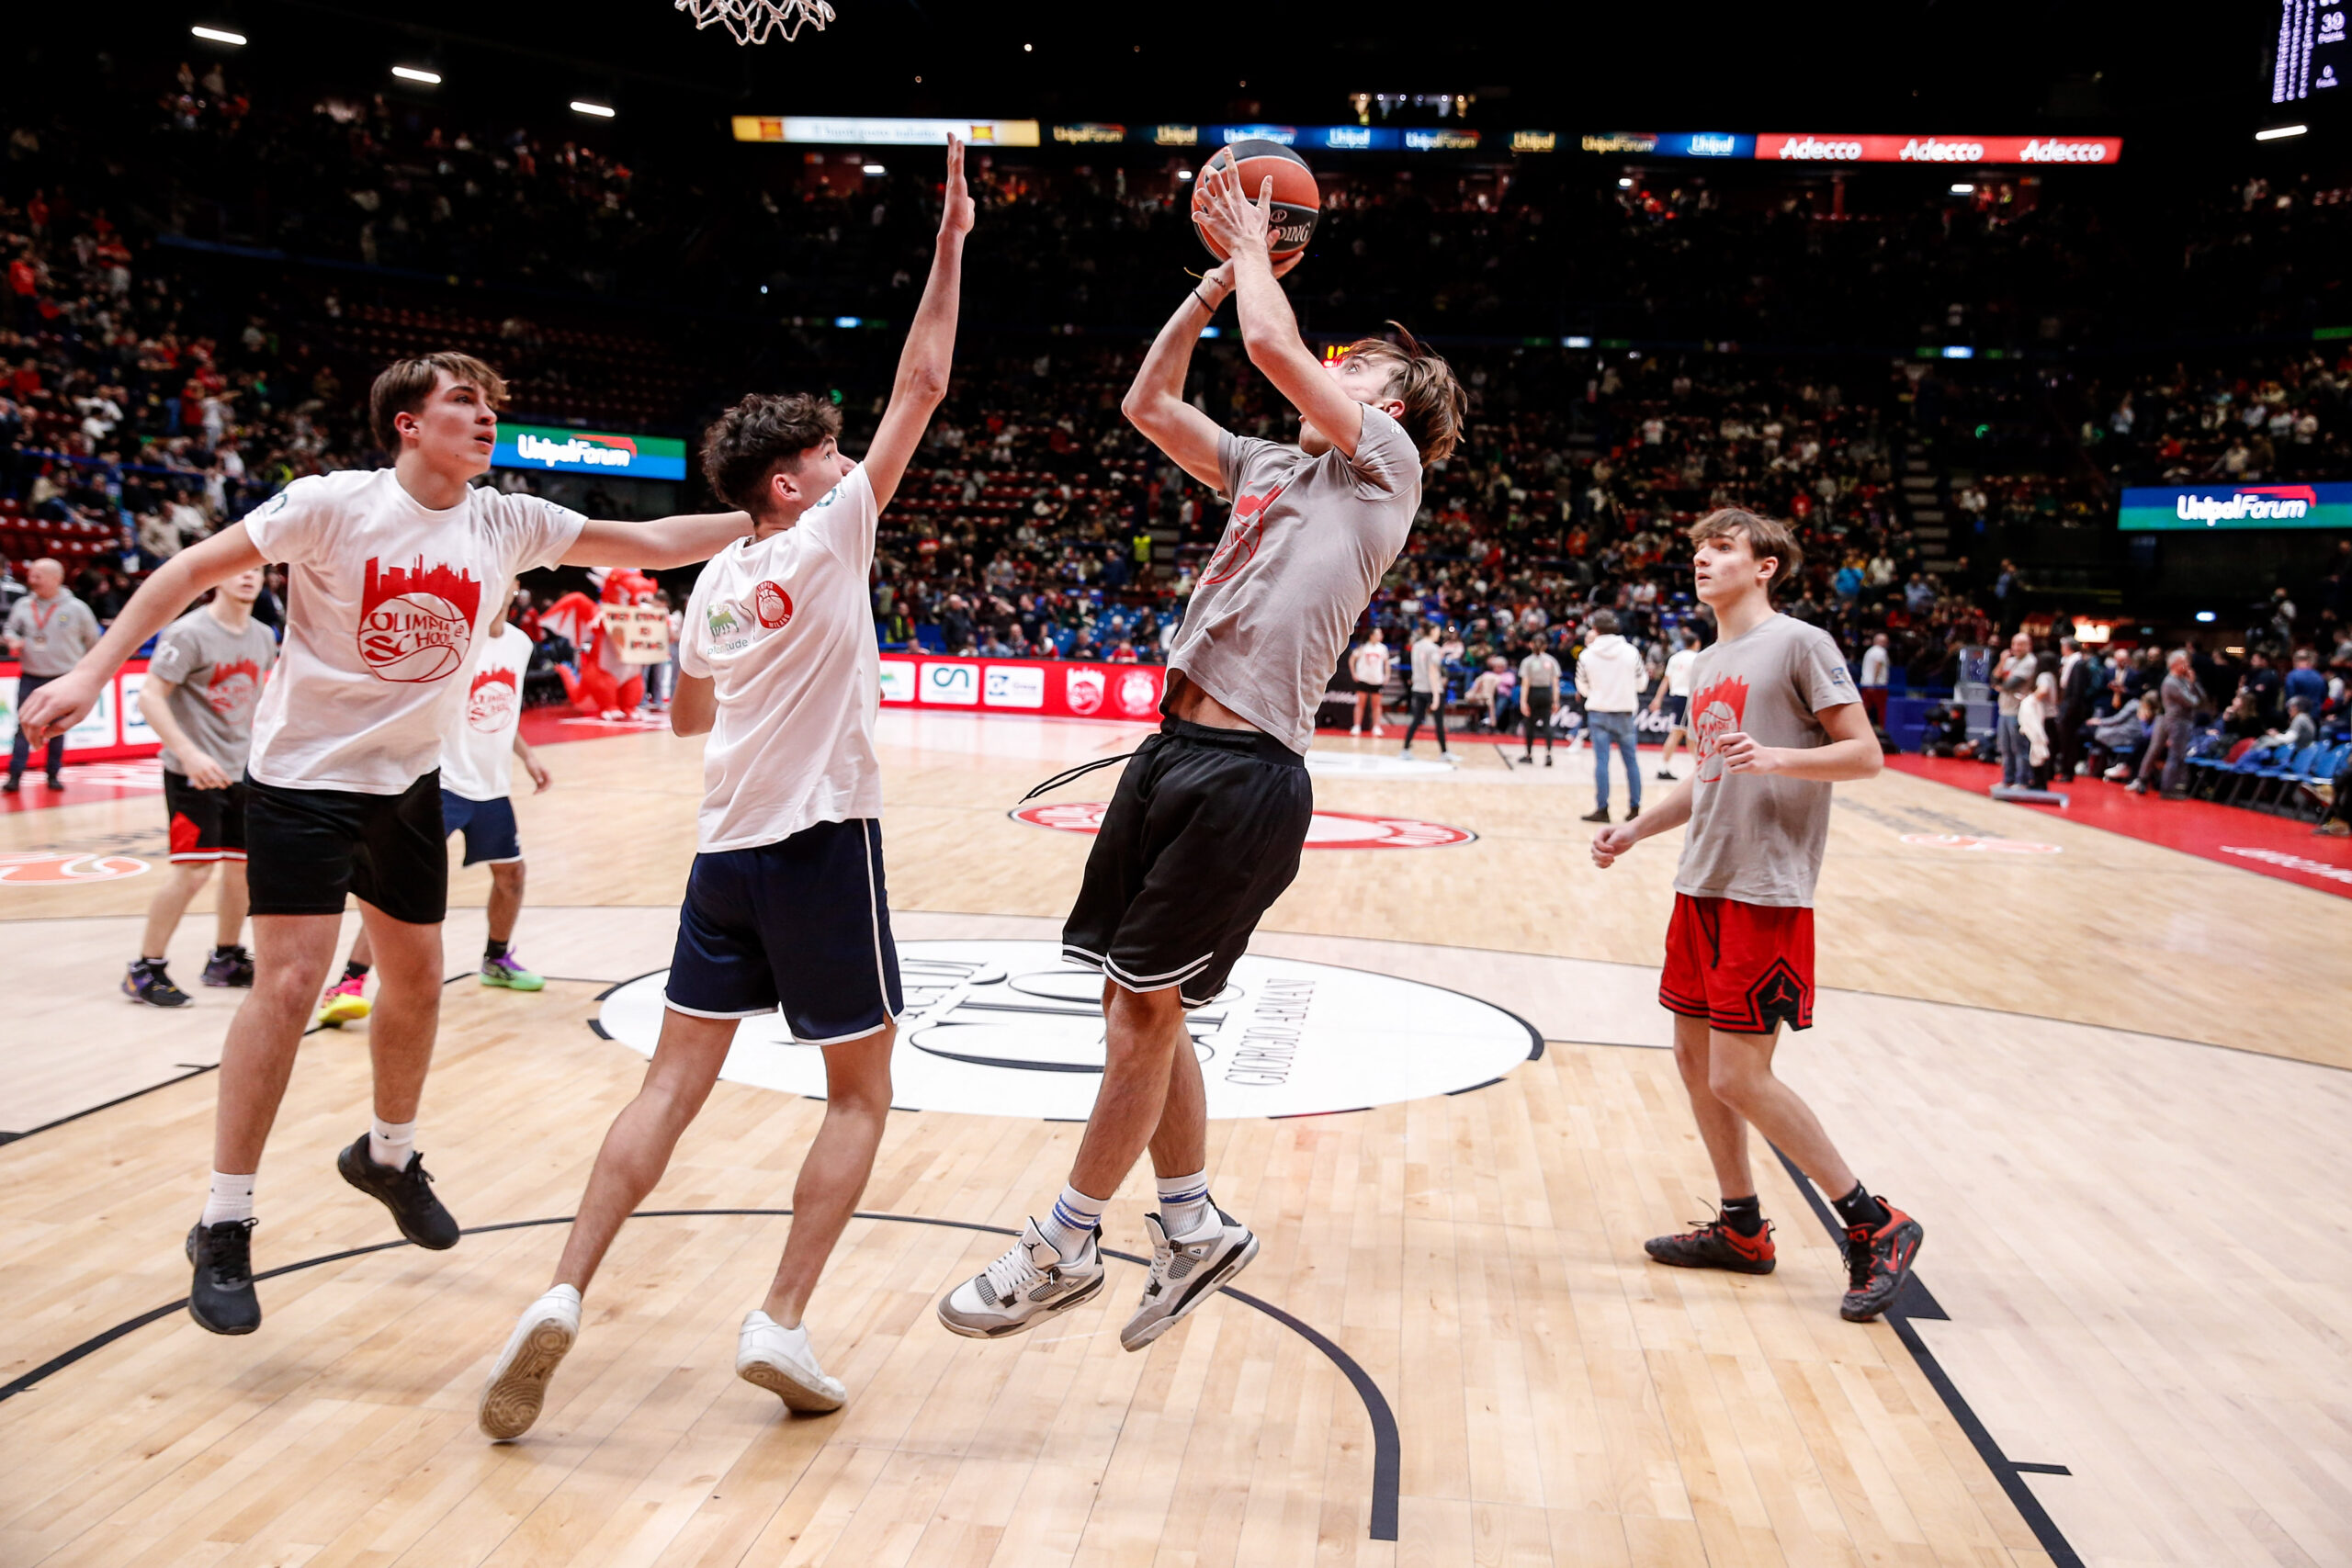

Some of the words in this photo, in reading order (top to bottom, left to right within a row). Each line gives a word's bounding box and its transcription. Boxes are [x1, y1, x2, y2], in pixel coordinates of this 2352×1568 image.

[1157, 126, 1197, 145] Unipol
[1329, 128, 1370, 148] Unipol
[1513, 131, 1555, 152] Unipol
[1692, 135, 1735, 155] Unipol
[1779, 137, 1862, 160] Adecco
[1899, 138, 1984, 162] Adecco
[2019, 139, 2106, 162] Adecco
[517, 434, 631, 468] UnipolForum
[2177, 493, 2307, 526] UnipolForum
[369, 612, 450, 634] OLIMPIA
[768, 614, 791, 628] MILANO
[364, 632, 455, 662] SCHOOL
[1253, 978, 1316, 1025] ARMANI
[1224, 1026, 1301, 1086] GIORGIO
